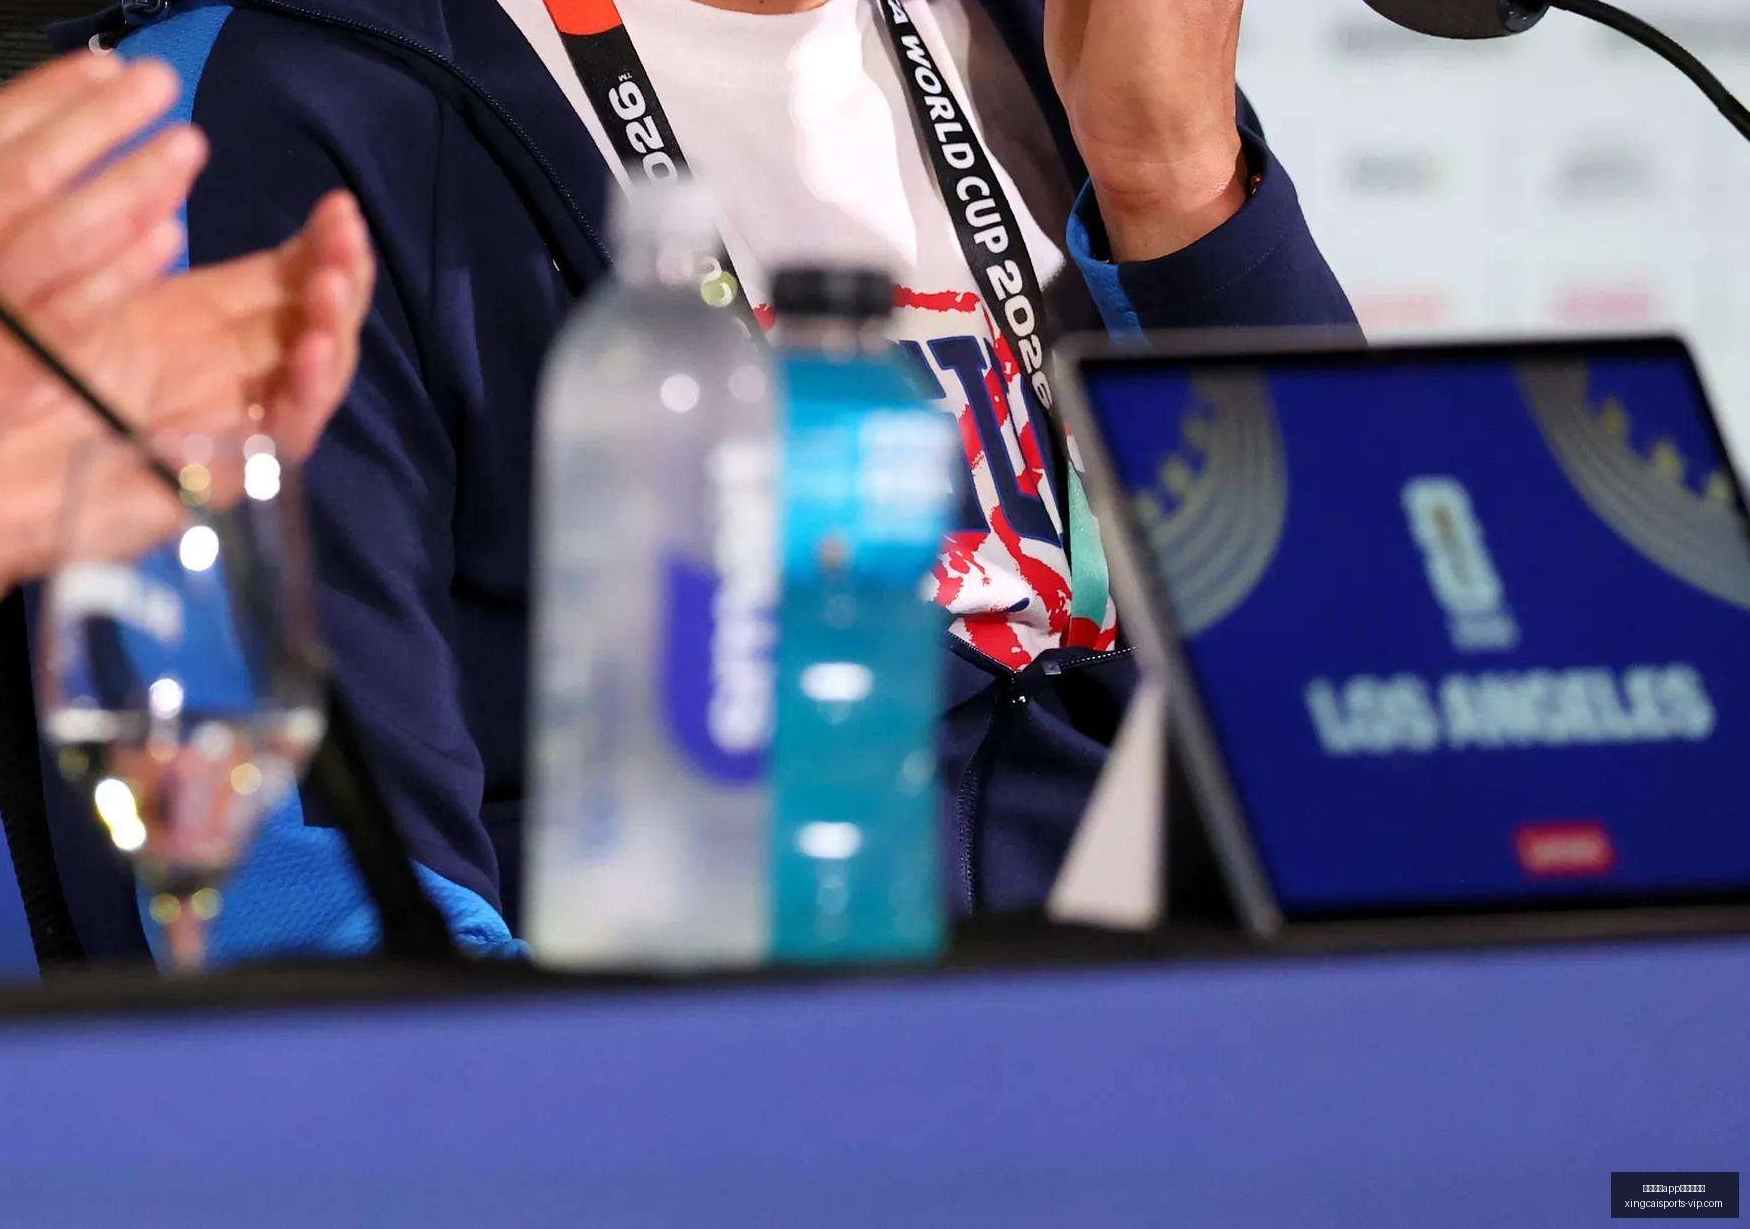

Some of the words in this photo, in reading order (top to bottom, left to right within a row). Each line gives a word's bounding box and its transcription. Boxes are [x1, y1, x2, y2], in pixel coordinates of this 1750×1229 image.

[901, 34, 975, 169] WORLD
[956, 175, 1010, 254] CUP
[986, 260, 1052, 411] 2026
